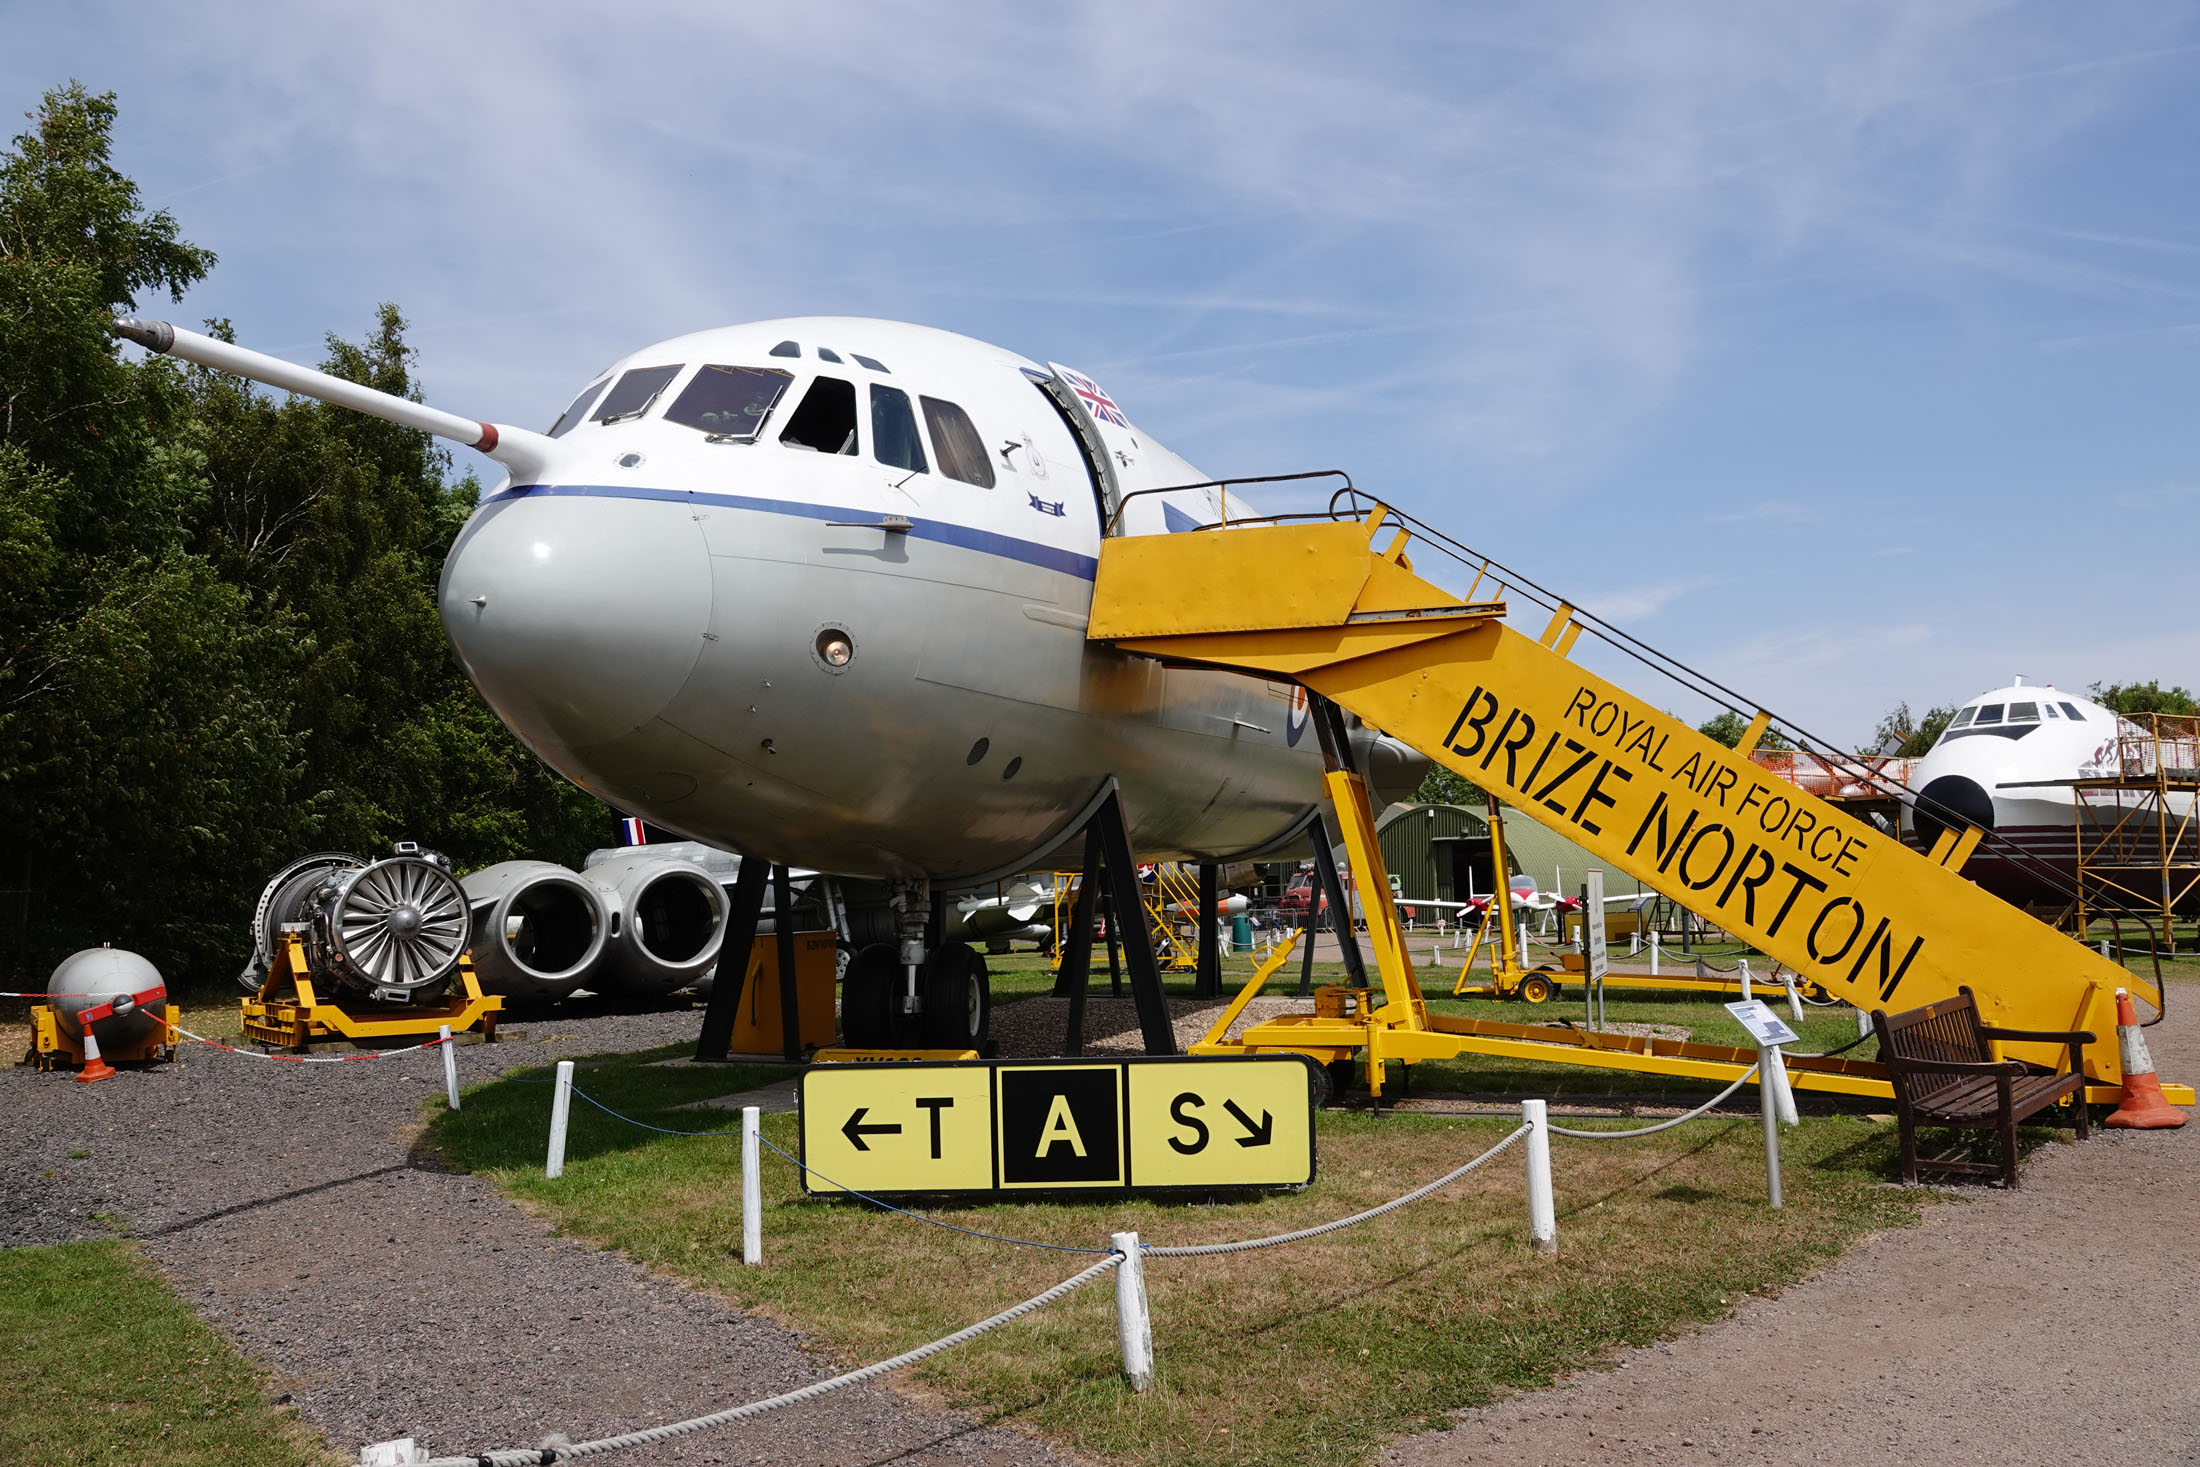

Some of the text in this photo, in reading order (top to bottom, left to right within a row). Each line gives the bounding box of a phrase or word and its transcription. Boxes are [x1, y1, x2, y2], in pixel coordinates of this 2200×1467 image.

[1441, 685, 1925, 1003] BRIZE NORTON
[1563, 686, 1868, 878] ROYAL AIR FORCE
[915, 1092, 1210, 1160] T A S
